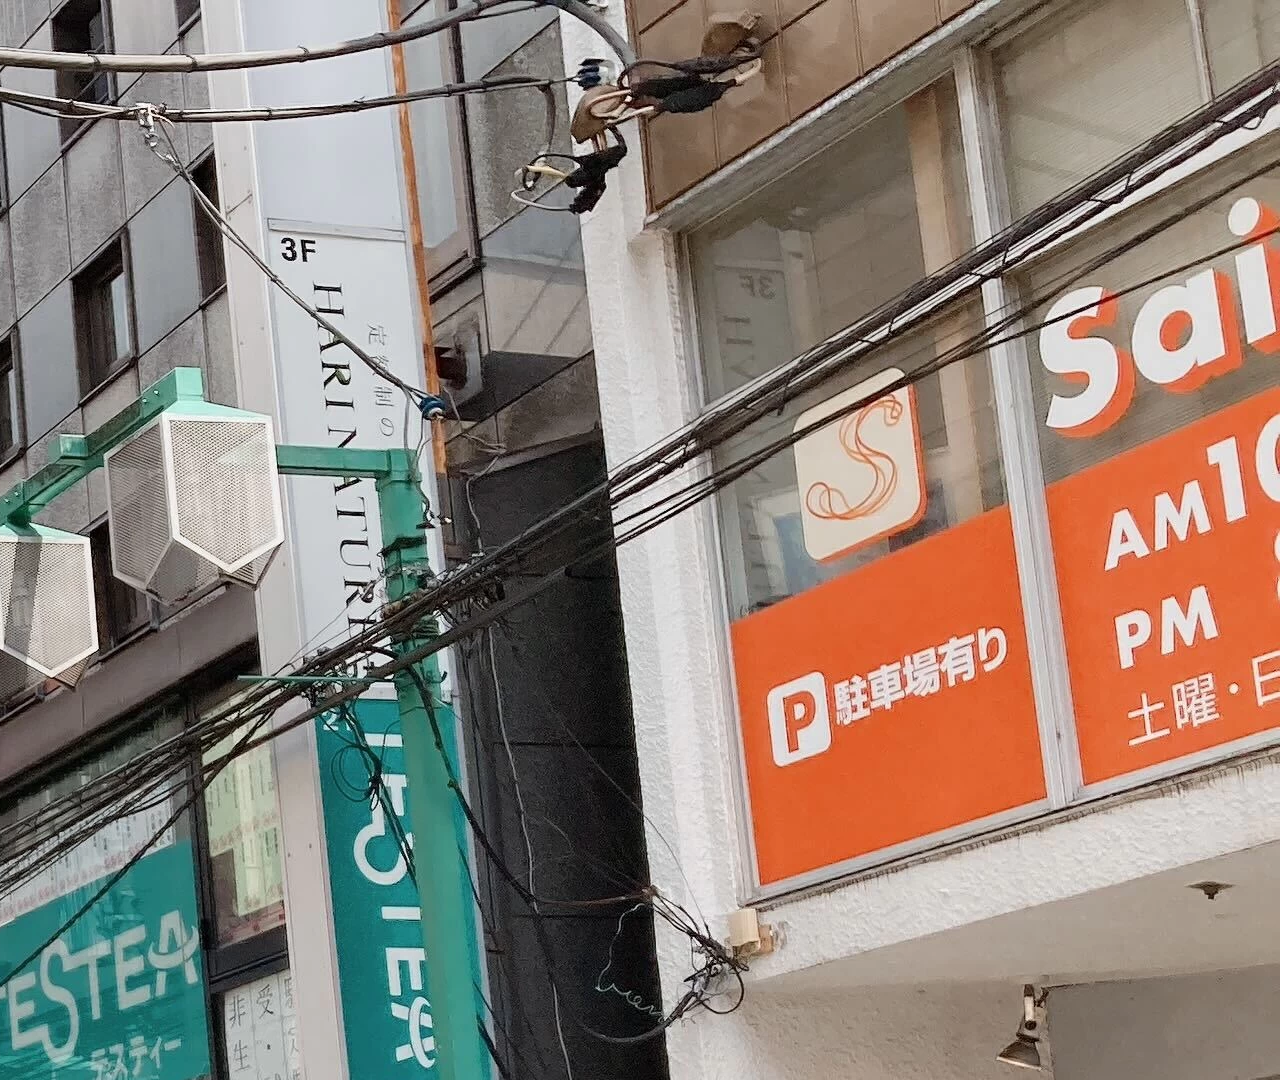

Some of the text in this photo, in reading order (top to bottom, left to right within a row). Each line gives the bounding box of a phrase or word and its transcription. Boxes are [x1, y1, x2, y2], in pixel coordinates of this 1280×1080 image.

[280, 237, 317, 263] 3F
[1114, 584, 1219, 670] PM
[833, 626, 1008, 727] 駐車場有り
